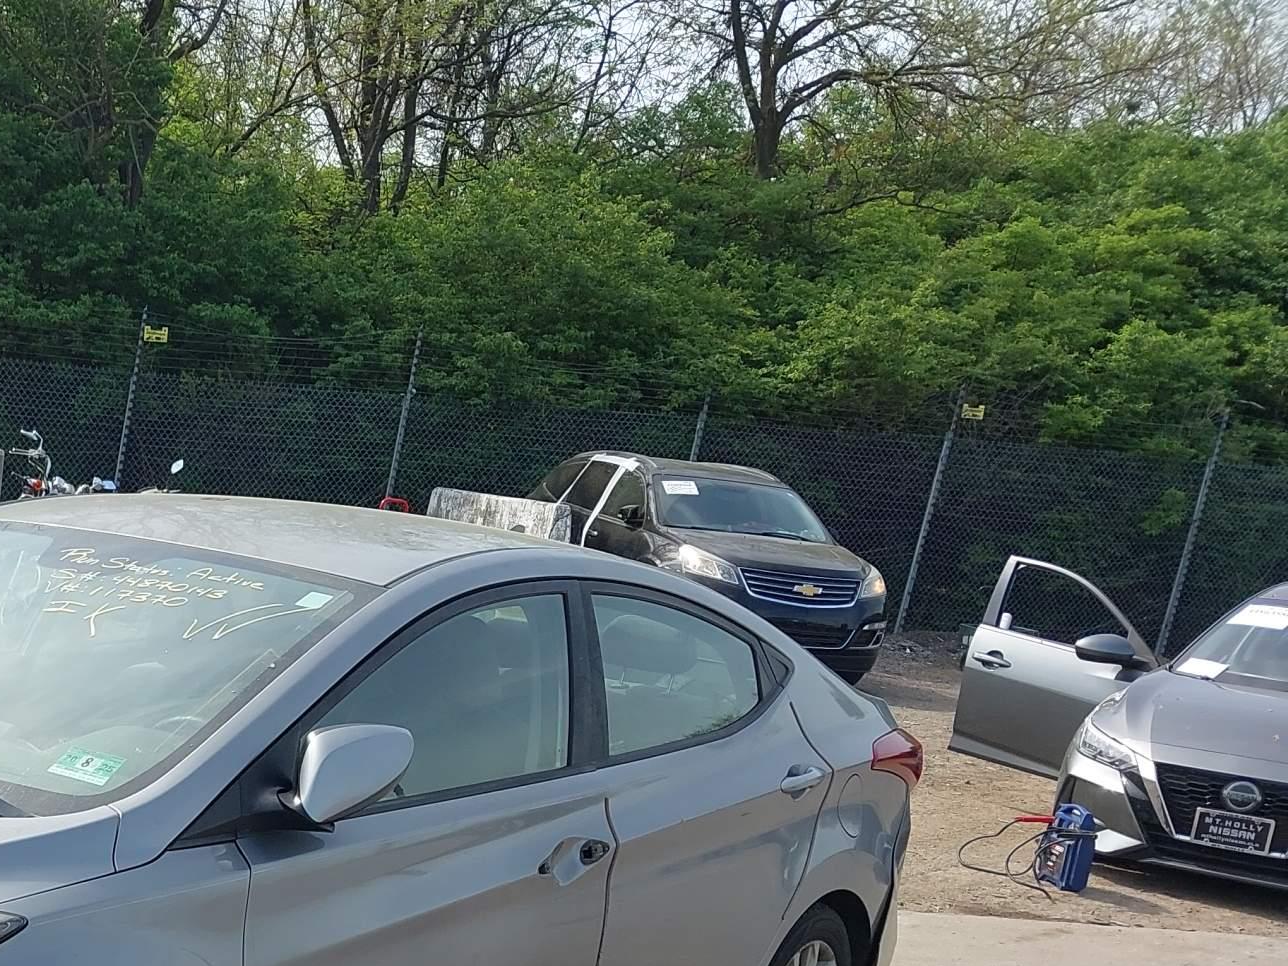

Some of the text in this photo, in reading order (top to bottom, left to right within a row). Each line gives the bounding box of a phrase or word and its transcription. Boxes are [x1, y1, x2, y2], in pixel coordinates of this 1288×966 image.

[59, 548, 100, 566] Run
[186, 567, 265, 591] Active
[89, 586, 189, 608] 117370
[111, 575, 230, 599] 44870143
[80, 757, 95, 768] 8
[1208, 825, 1256, 841] NISSAN
